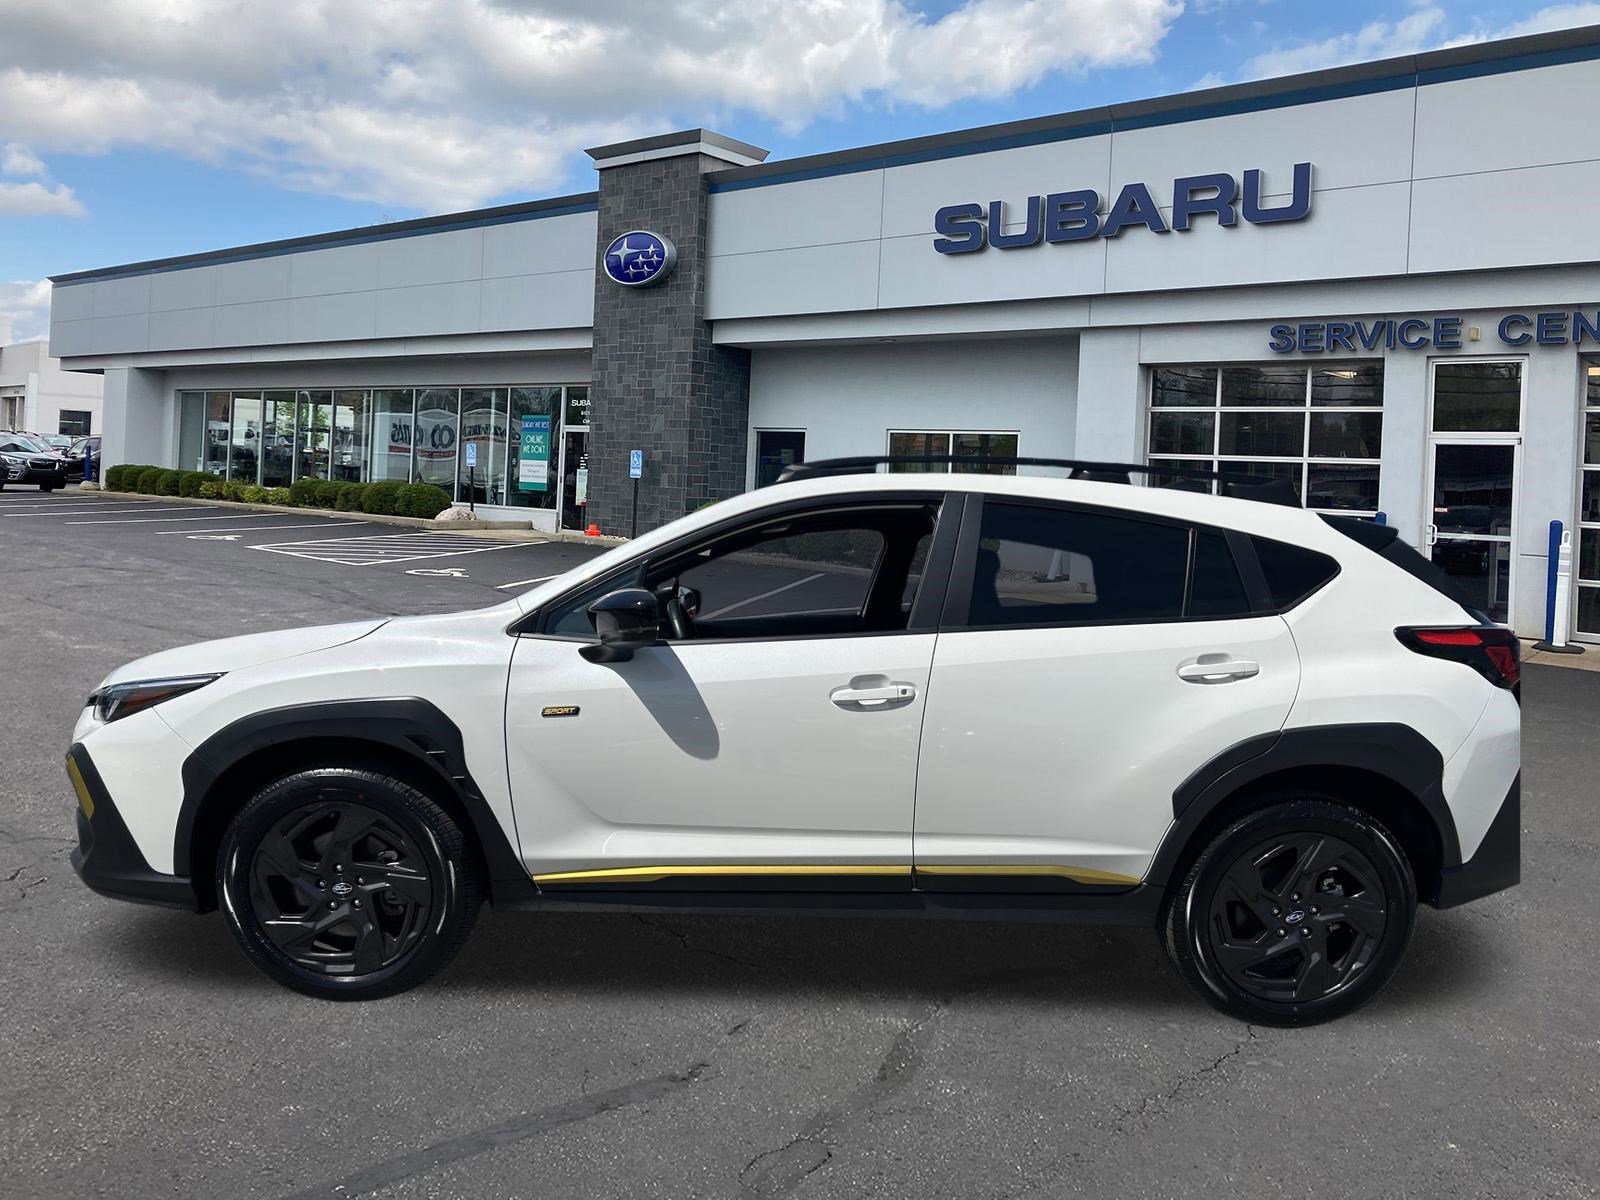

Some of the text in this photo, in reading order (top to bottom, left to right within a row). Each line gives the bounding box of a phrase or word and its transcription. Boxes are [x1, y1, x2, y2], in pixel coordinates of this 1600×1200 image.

[933, 162, 1314, 255] SUBARU
[1269, 311, 1600, 353] SERVICE CEN
[543, 707, 576, 715] SPORT
